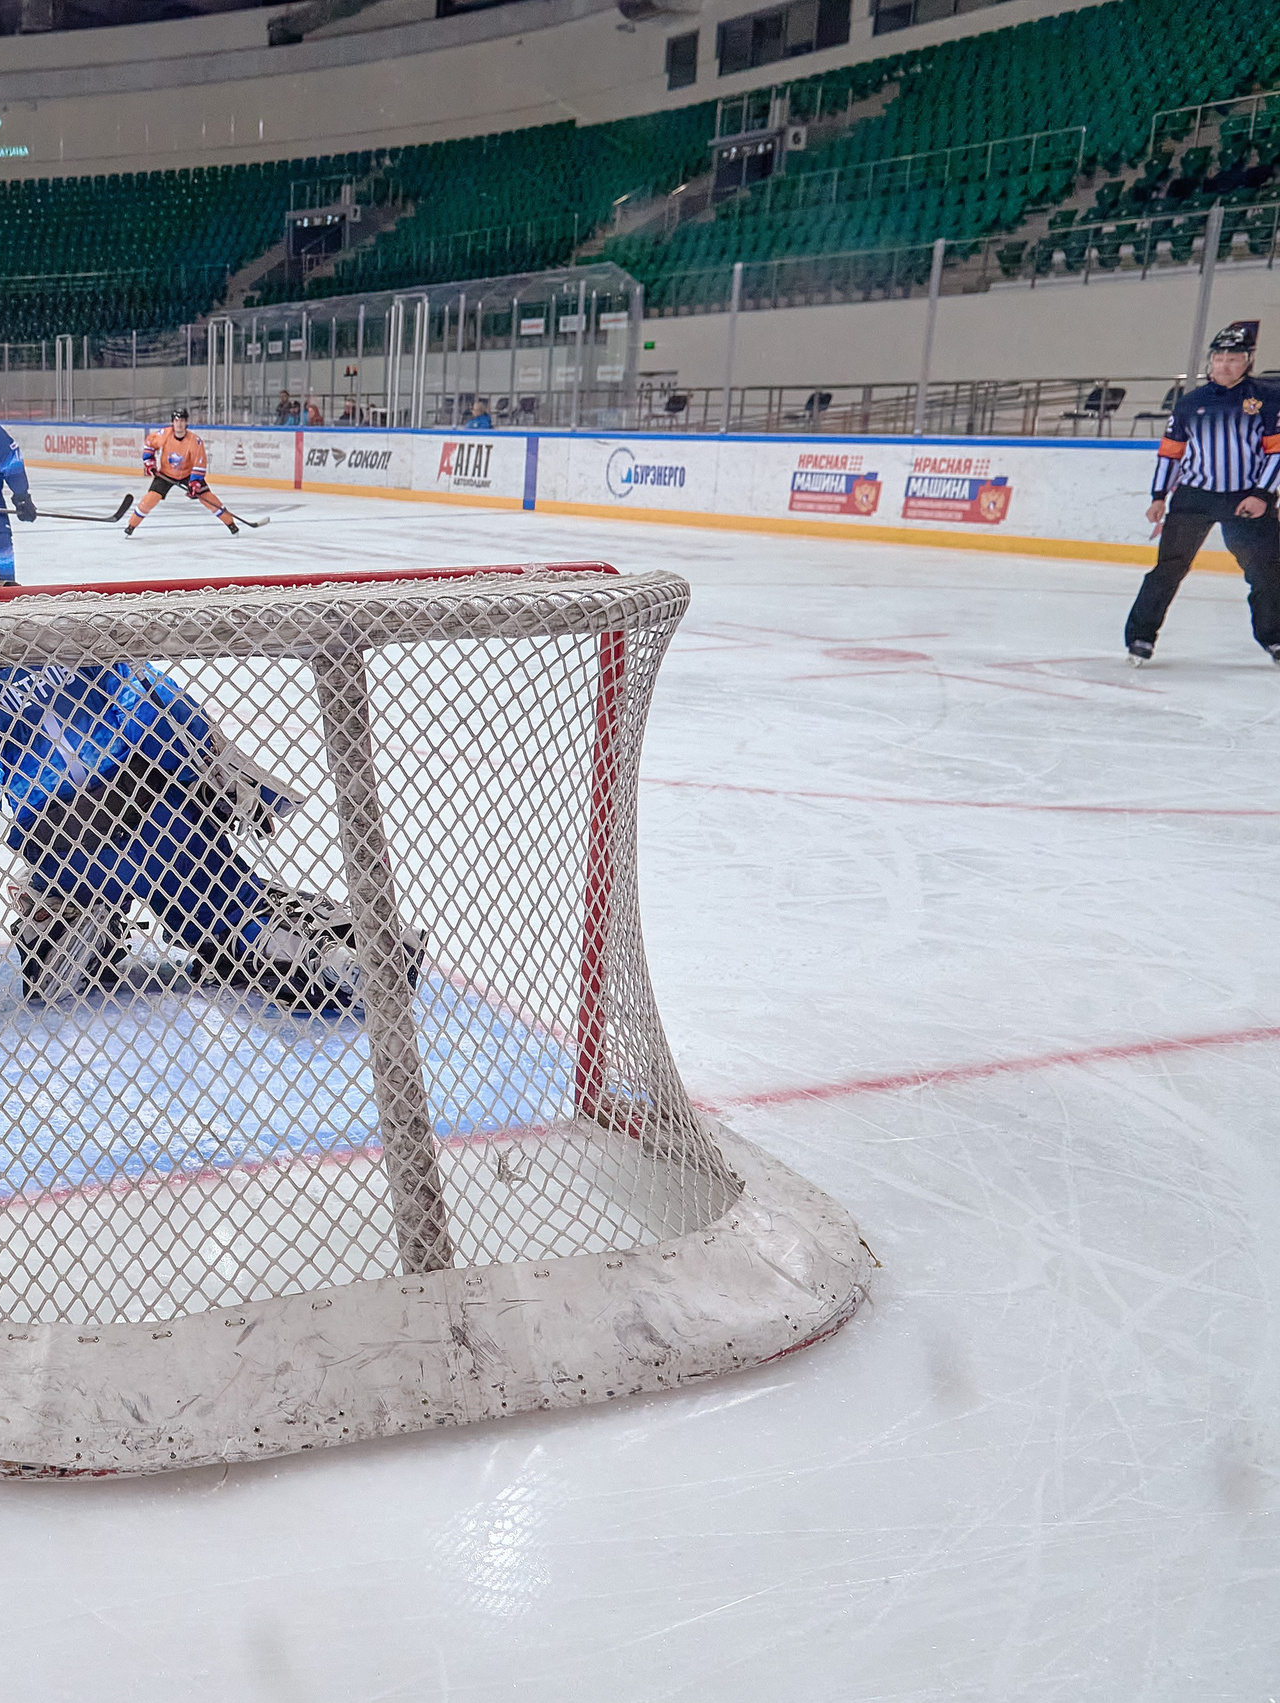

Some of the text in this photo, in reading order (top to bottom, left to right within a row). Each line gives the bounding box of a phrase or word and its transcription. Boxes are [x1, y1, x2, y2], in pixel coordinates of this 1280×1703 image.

[45, 435, 98, 456] OLIMPBET
[347, 449, 392, 470] СОКОЛ!
[454, 443, 494, 478] АГАТ
[797, 454, 849, 471] КРАСНАЯ
[913, 457, 973, 475] КРАСНАЯ
[634, 464, 686, 487] БУРЭНЕРГО
[793, 473, 847, 493] МАШИНА
[907, 478, 970, 500] МАШИНА
